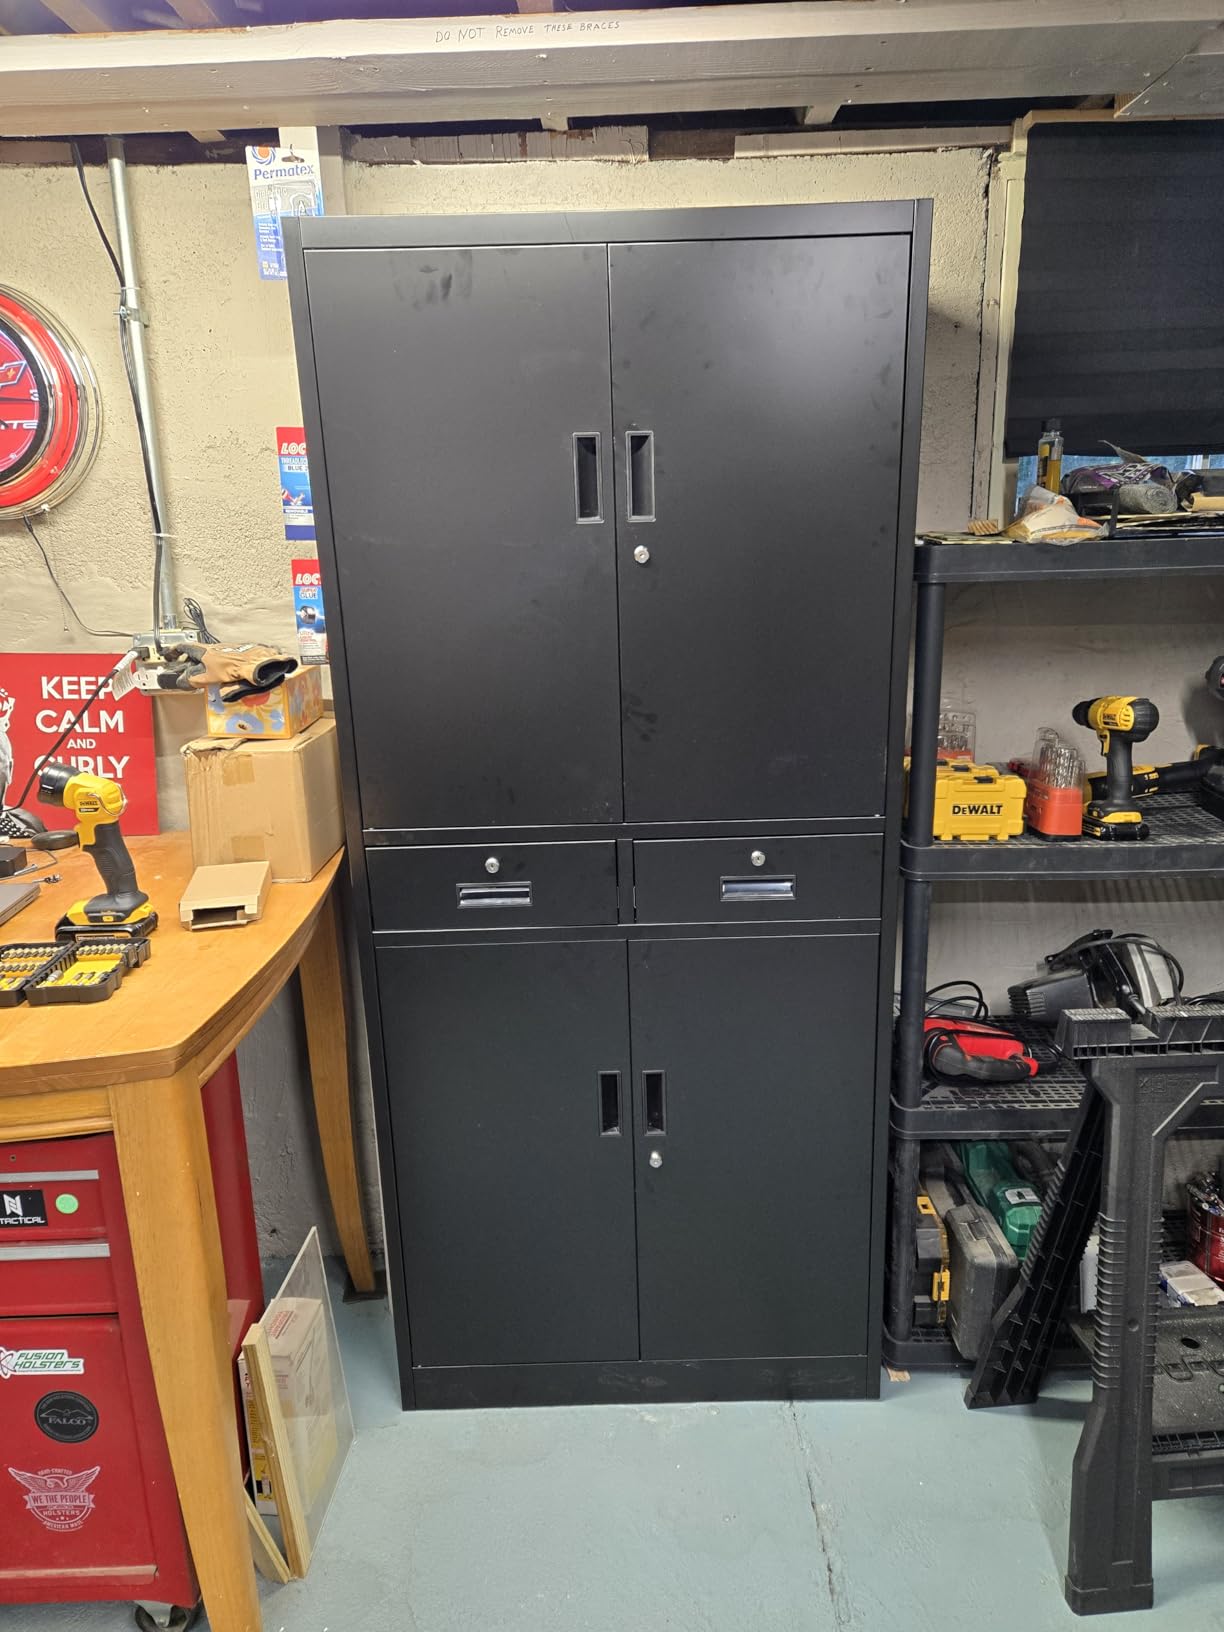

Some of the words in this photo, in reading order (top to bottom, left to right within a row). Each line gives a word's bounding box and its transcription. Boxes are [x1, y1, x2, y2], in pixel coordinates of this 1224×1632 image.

[435, 31, 451, 43] DO
[458, 27, 485, 42] NOT
[496, 25, 534, 39] REMOVE
[544, 23, 573, 33] THESE
[580, 20, 620, 32] BRACES
[254, 164, 314, 181] Permatex
[41, 676, 114, 700] KEEP
[35, 709, 124, 733] CALM
[67, 738, 96, 749] AND
[0, 1216, 45, 1225] TACTICAL
[48, 1416, 87, 1425] FALCO
[31, 1494, 42, 1504] WE
[45, 1494, 58, 1504] THE
[60, 1494, 87, 1504] PEOPLE
